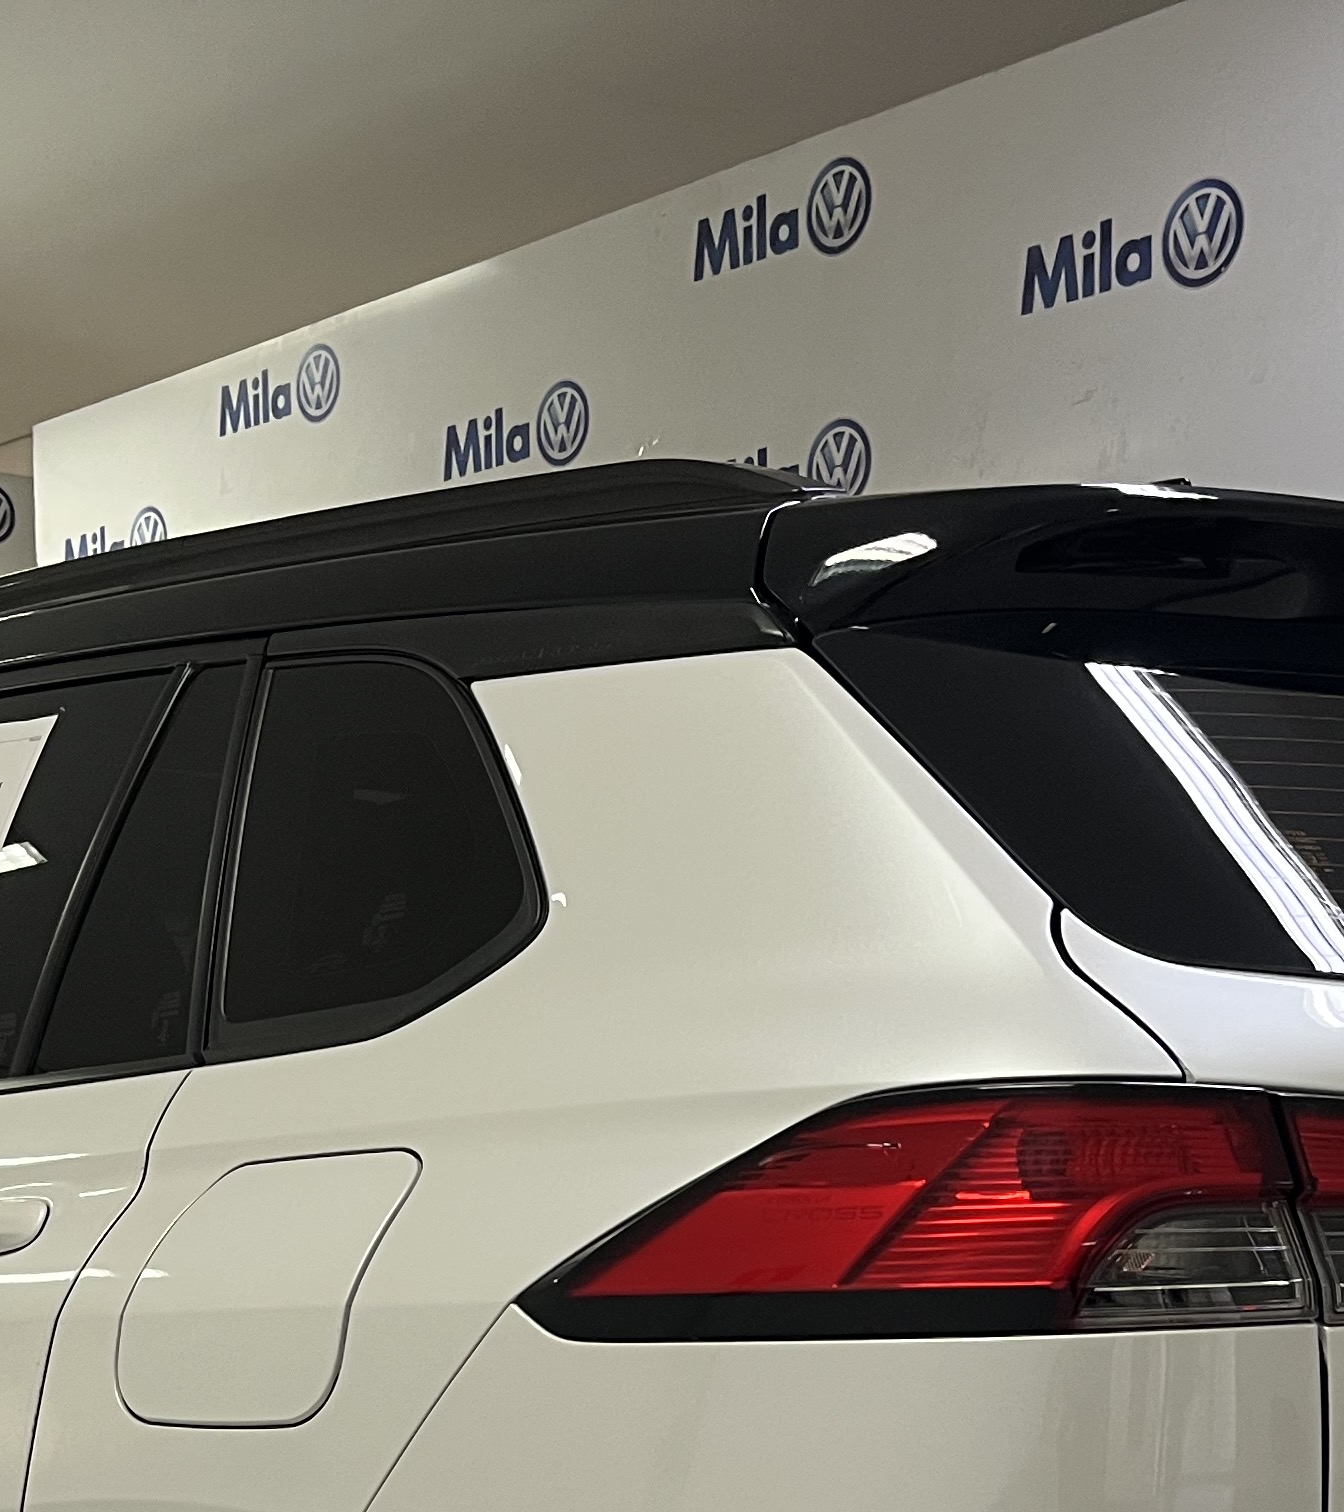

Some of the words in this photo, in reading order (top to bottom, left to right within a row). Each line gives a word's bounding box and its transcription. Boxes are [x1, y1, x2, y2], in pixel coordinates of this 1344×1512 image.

[694, 194, 799, 281] Mila
[1021, 219, 1152, 315] Mila
[220, 369, 291, 437] Mila
[444, 408, 530, 481] Mila
